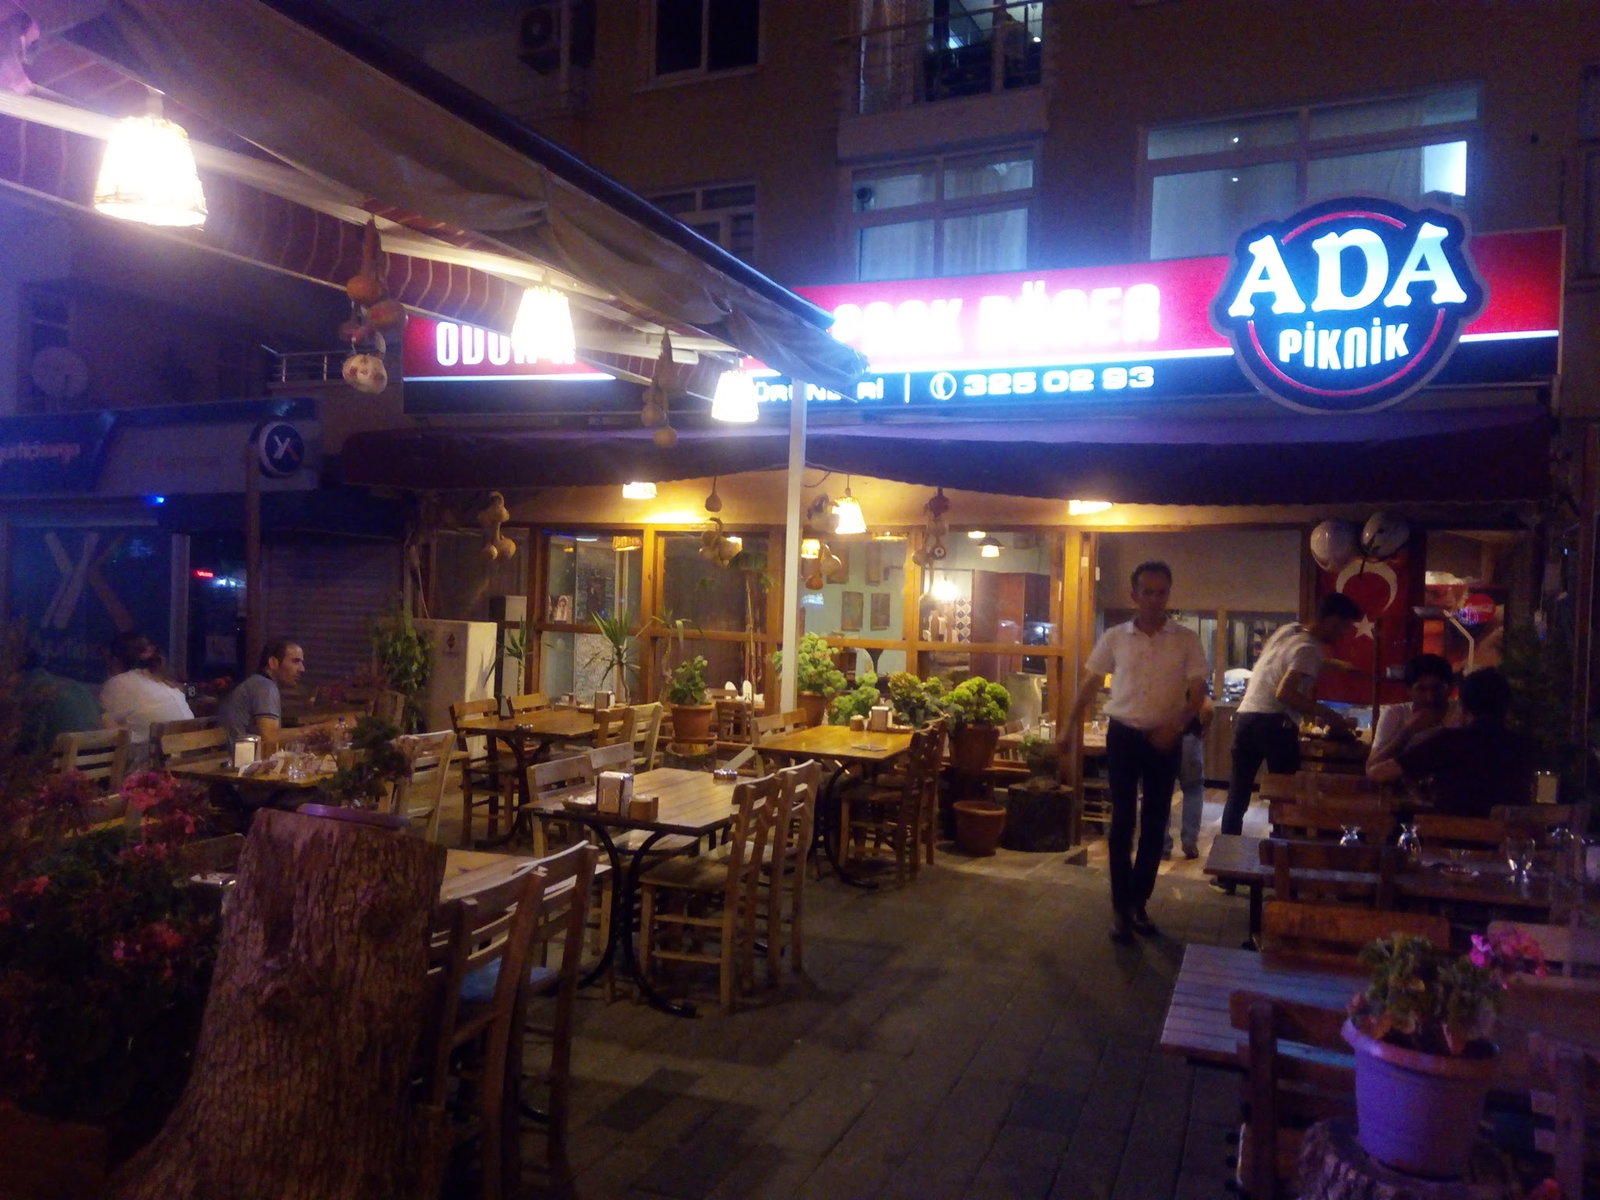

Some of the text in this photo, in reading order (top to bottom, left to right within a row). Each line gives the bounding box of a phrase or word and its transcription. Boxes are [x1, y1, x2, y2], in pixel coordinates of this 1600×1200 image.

[1228, 221, 1467, 317] ADA
[963, 371, 1037, 397] 325
[1042, 369, 1095, 394] 02
